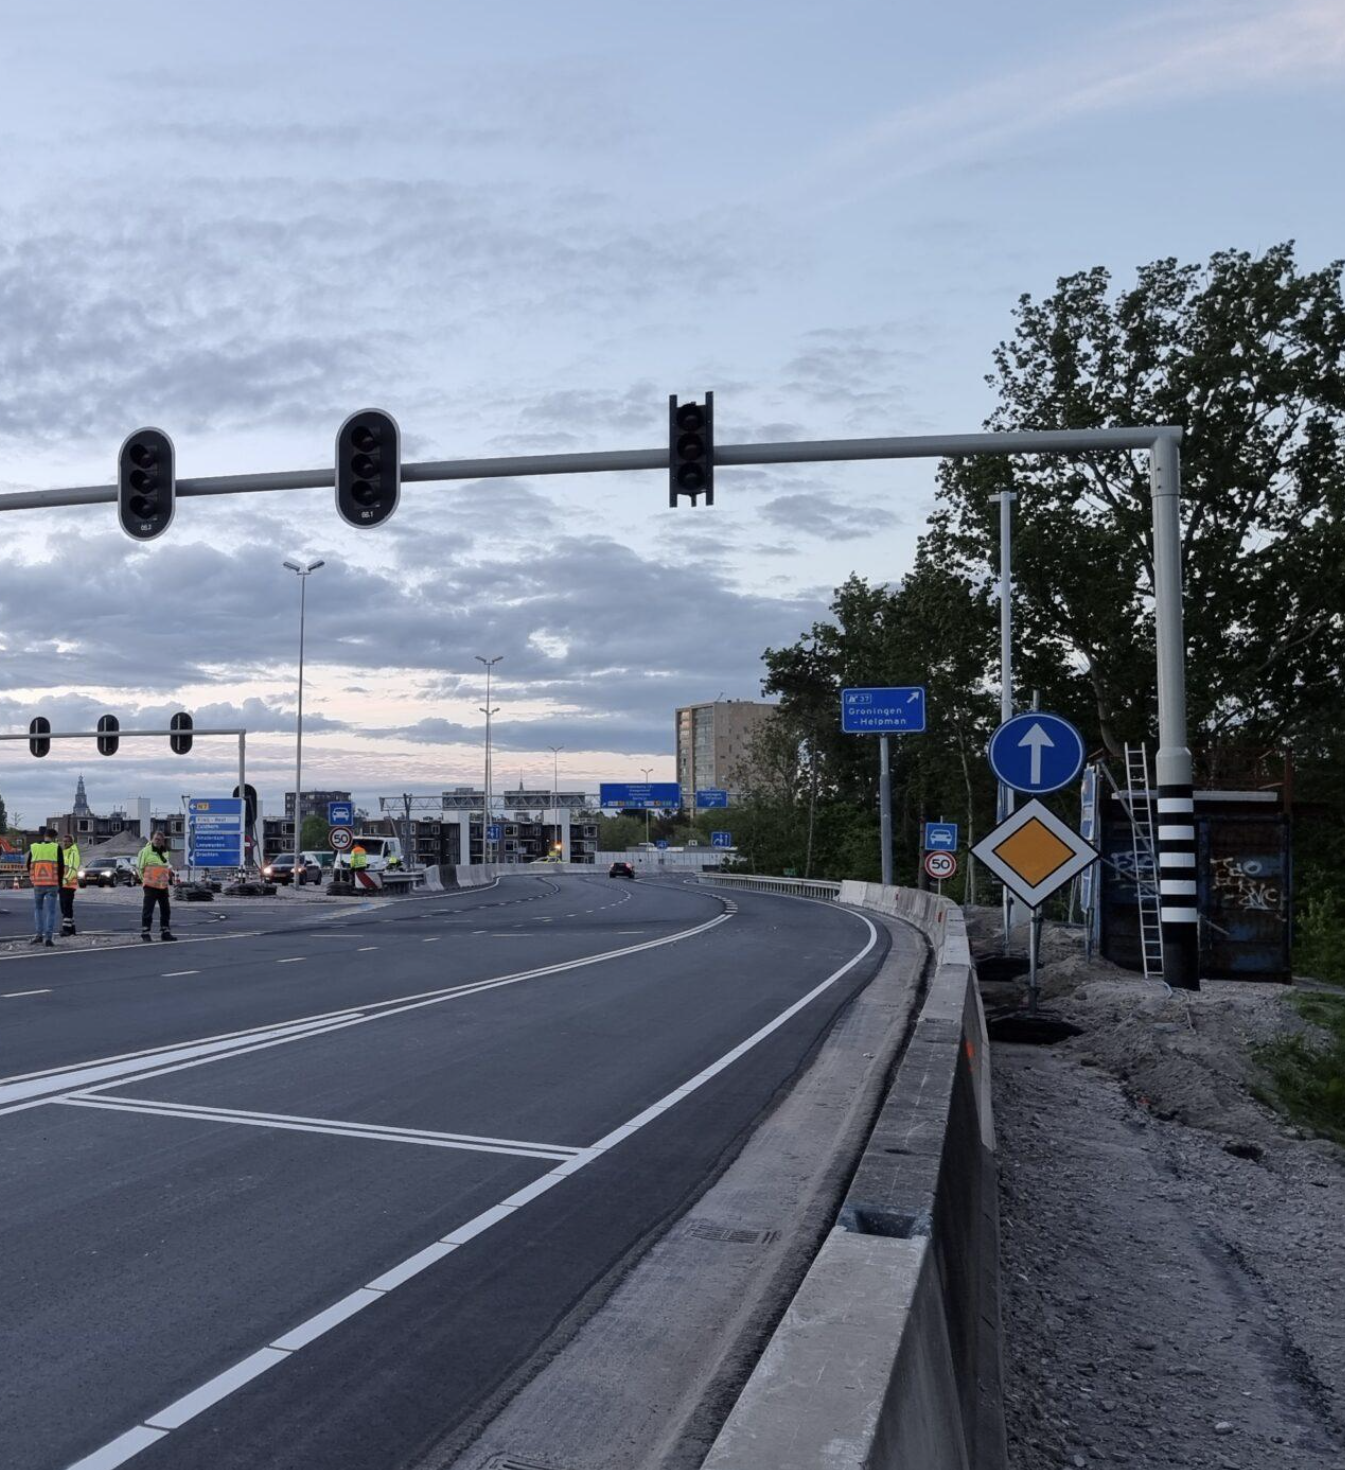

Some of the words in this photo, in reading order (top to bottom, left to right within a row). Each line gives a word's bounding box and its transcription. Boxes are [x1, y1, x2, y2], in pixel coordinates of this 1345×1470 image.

[848, 707, 902, 716] Groningen
[334, 834, 349, 844] 50
[932, 859, 950, 869] 50
